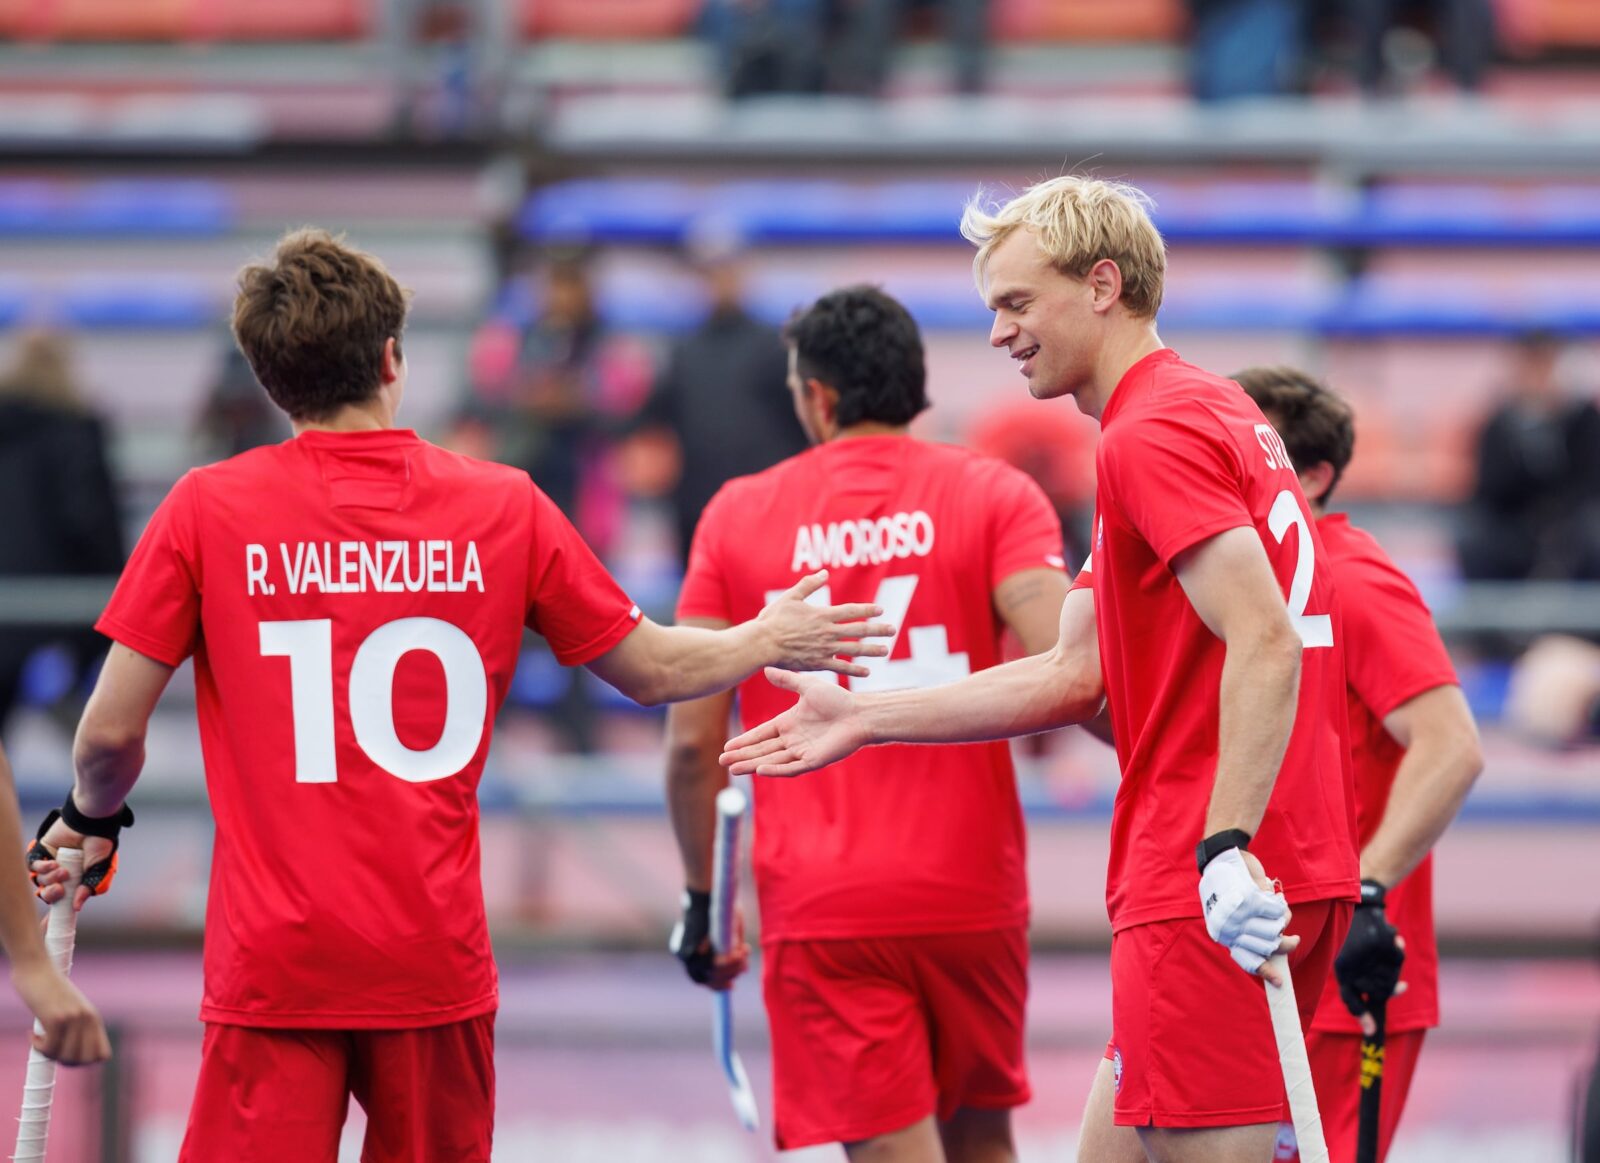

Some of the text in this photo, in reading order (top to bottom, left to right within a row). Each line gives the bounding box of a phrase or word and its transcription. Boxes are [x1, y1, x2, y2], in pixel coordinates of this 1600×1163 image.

[246, 540, 485, 595] R. VALENZUELA
[791, 510, 935, 572] AMOROSO
[1268, 490, 1333, 648] 2
[765, 574, 970, 693] 4
[258, 616, 488, 784] 10
